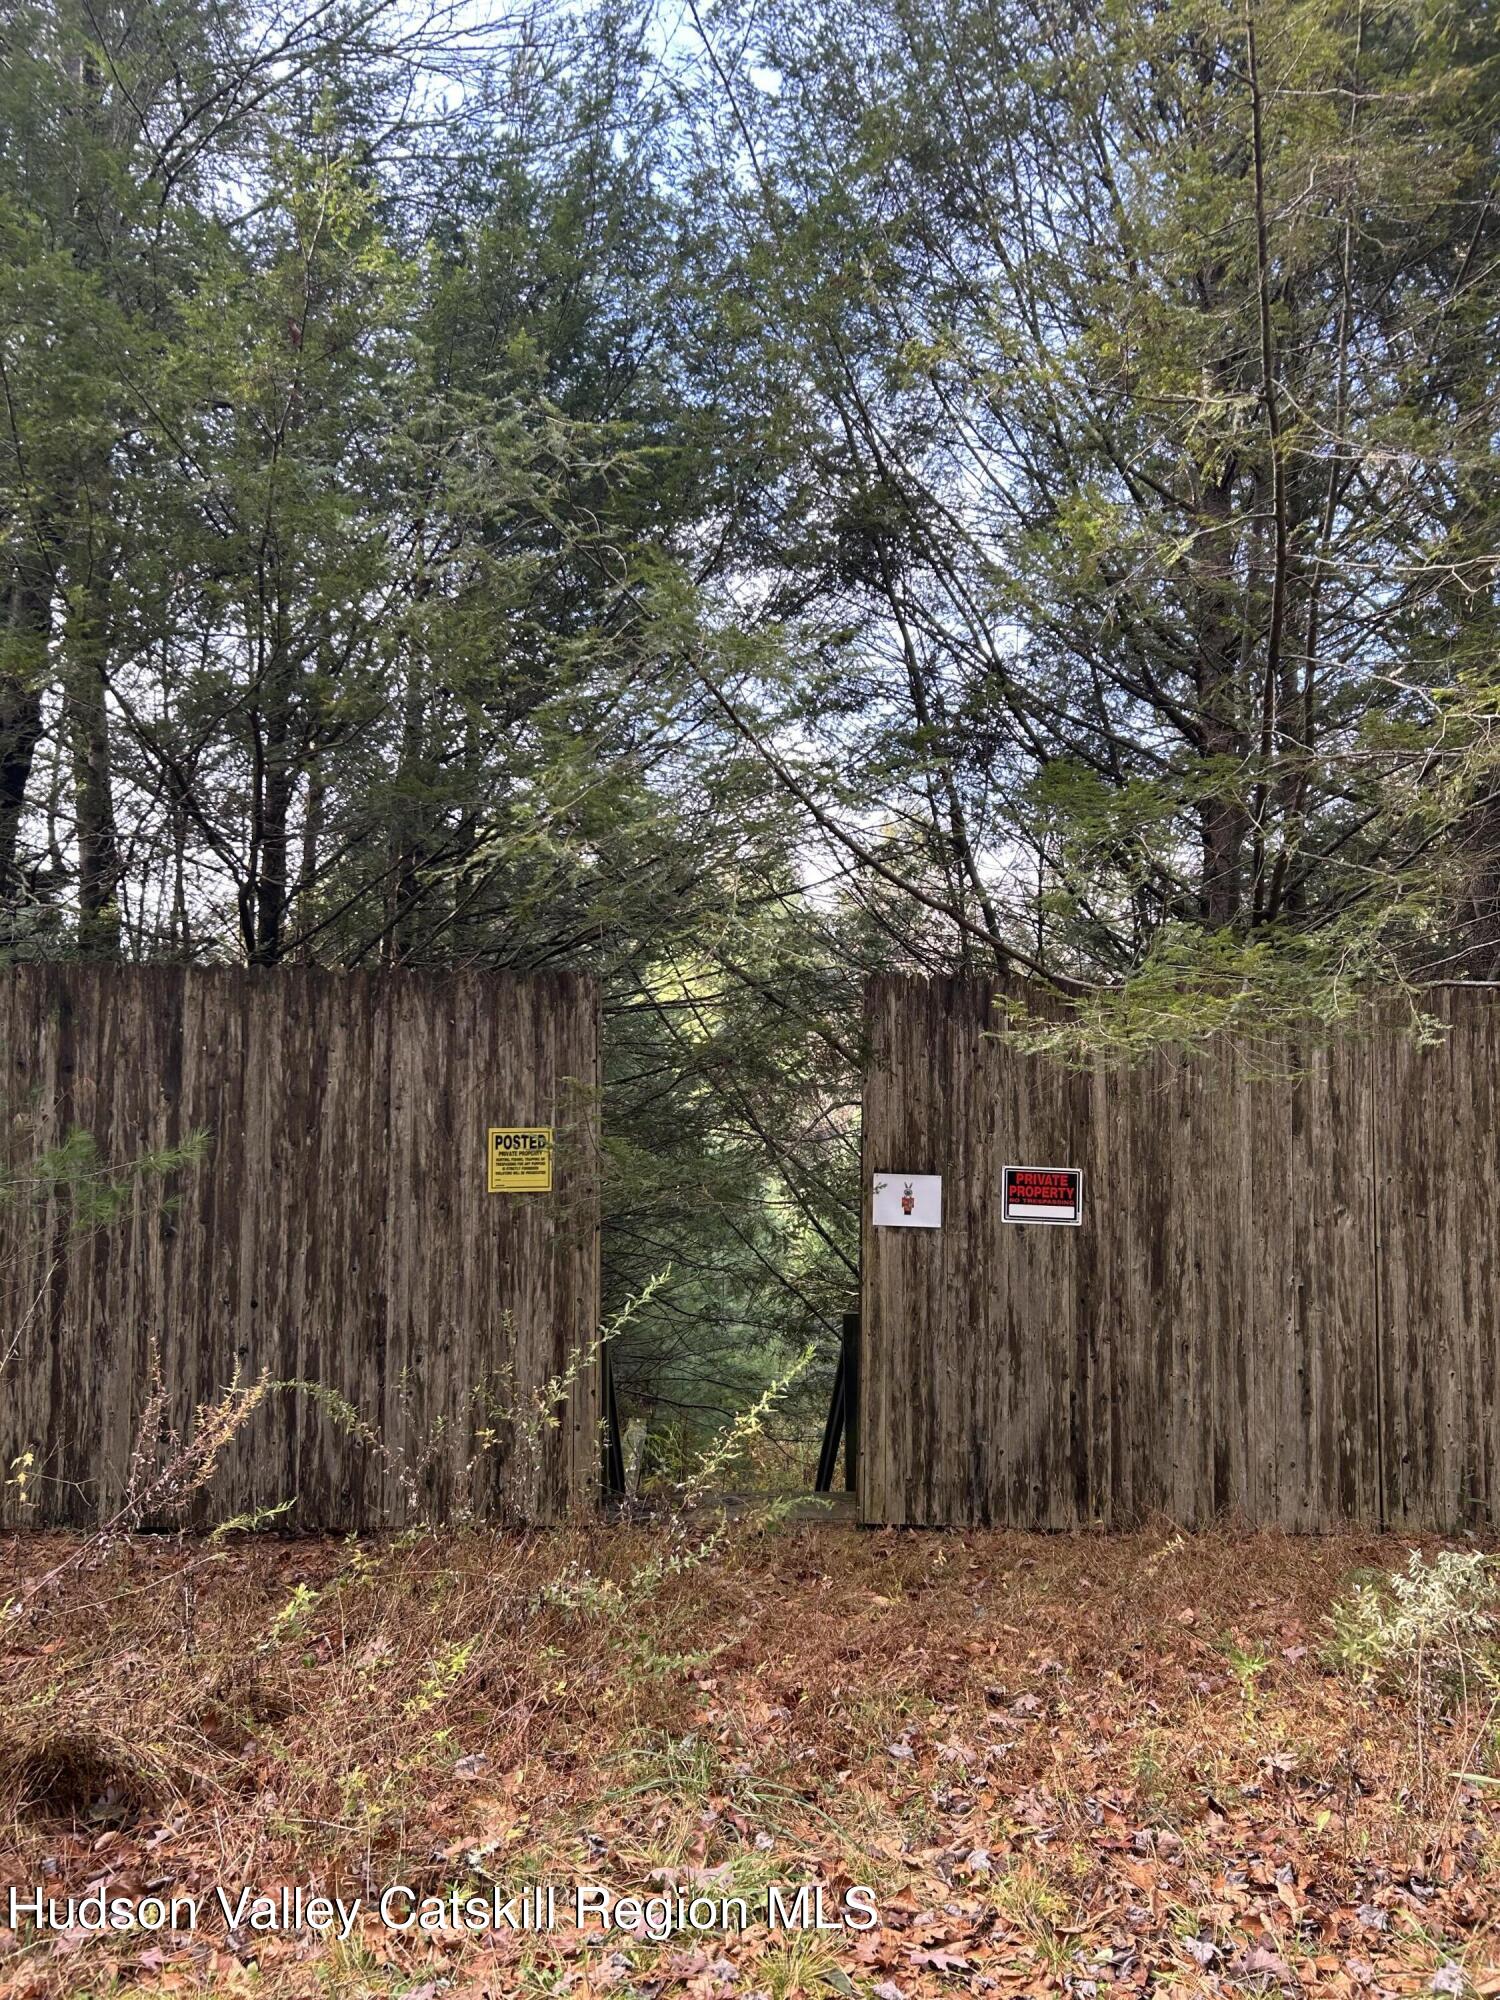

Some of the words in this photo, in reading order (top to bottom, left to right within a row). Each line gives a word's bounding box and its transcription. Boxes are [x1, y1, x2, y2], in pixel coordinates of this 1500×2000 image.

[495, 1134, 547, 1150] POSTED
[1015, 1173, 1069, 1187] PRIVATE
[1009, 1185, 1075, 1199] PROPERTY
[1022, 1198, 1075, 1206] TRESPASSING
